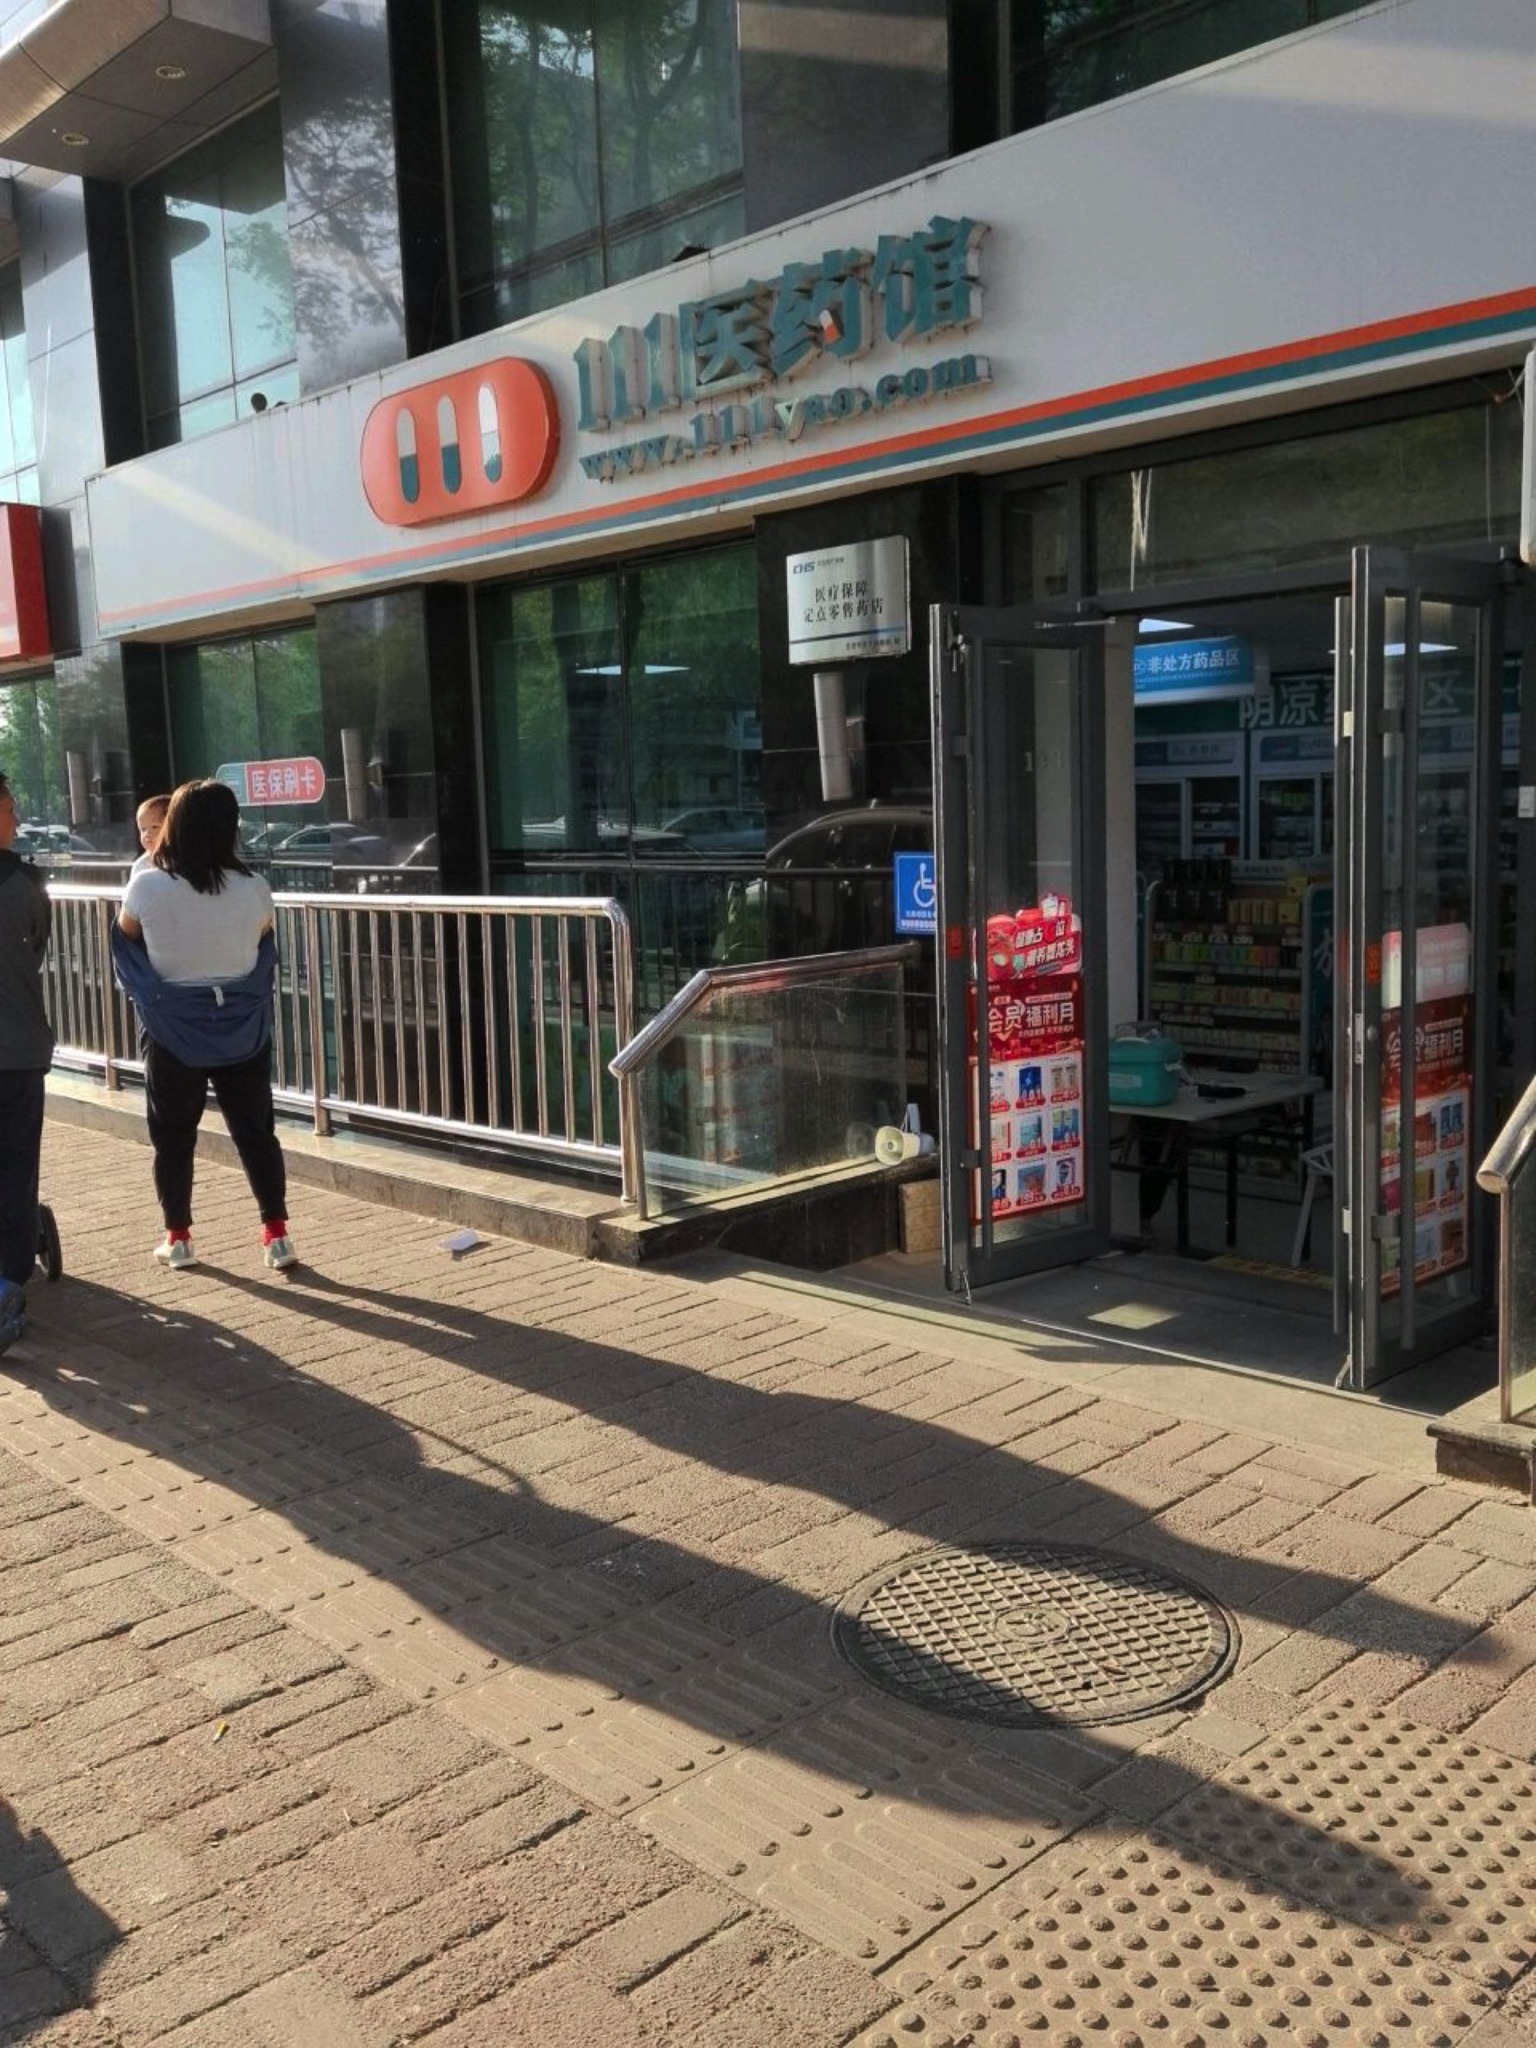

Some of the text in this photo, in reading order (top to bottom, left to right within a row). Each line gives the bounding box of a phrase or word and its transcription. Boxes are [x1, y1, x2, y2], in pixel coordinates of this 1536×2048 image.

[573, 213, 990, 433] 111医药馆
[579, 354, 992, 484] www.111yao.com
[793, 560, 815, 574] CHS
[815, 580, 868, 603] 医疗保障
[804, 598, 883, 623] 定点零售药店
[1150, 648, 1240, 674] 非处方药品区
[252, 764, 317, 798] 医保刷卡
